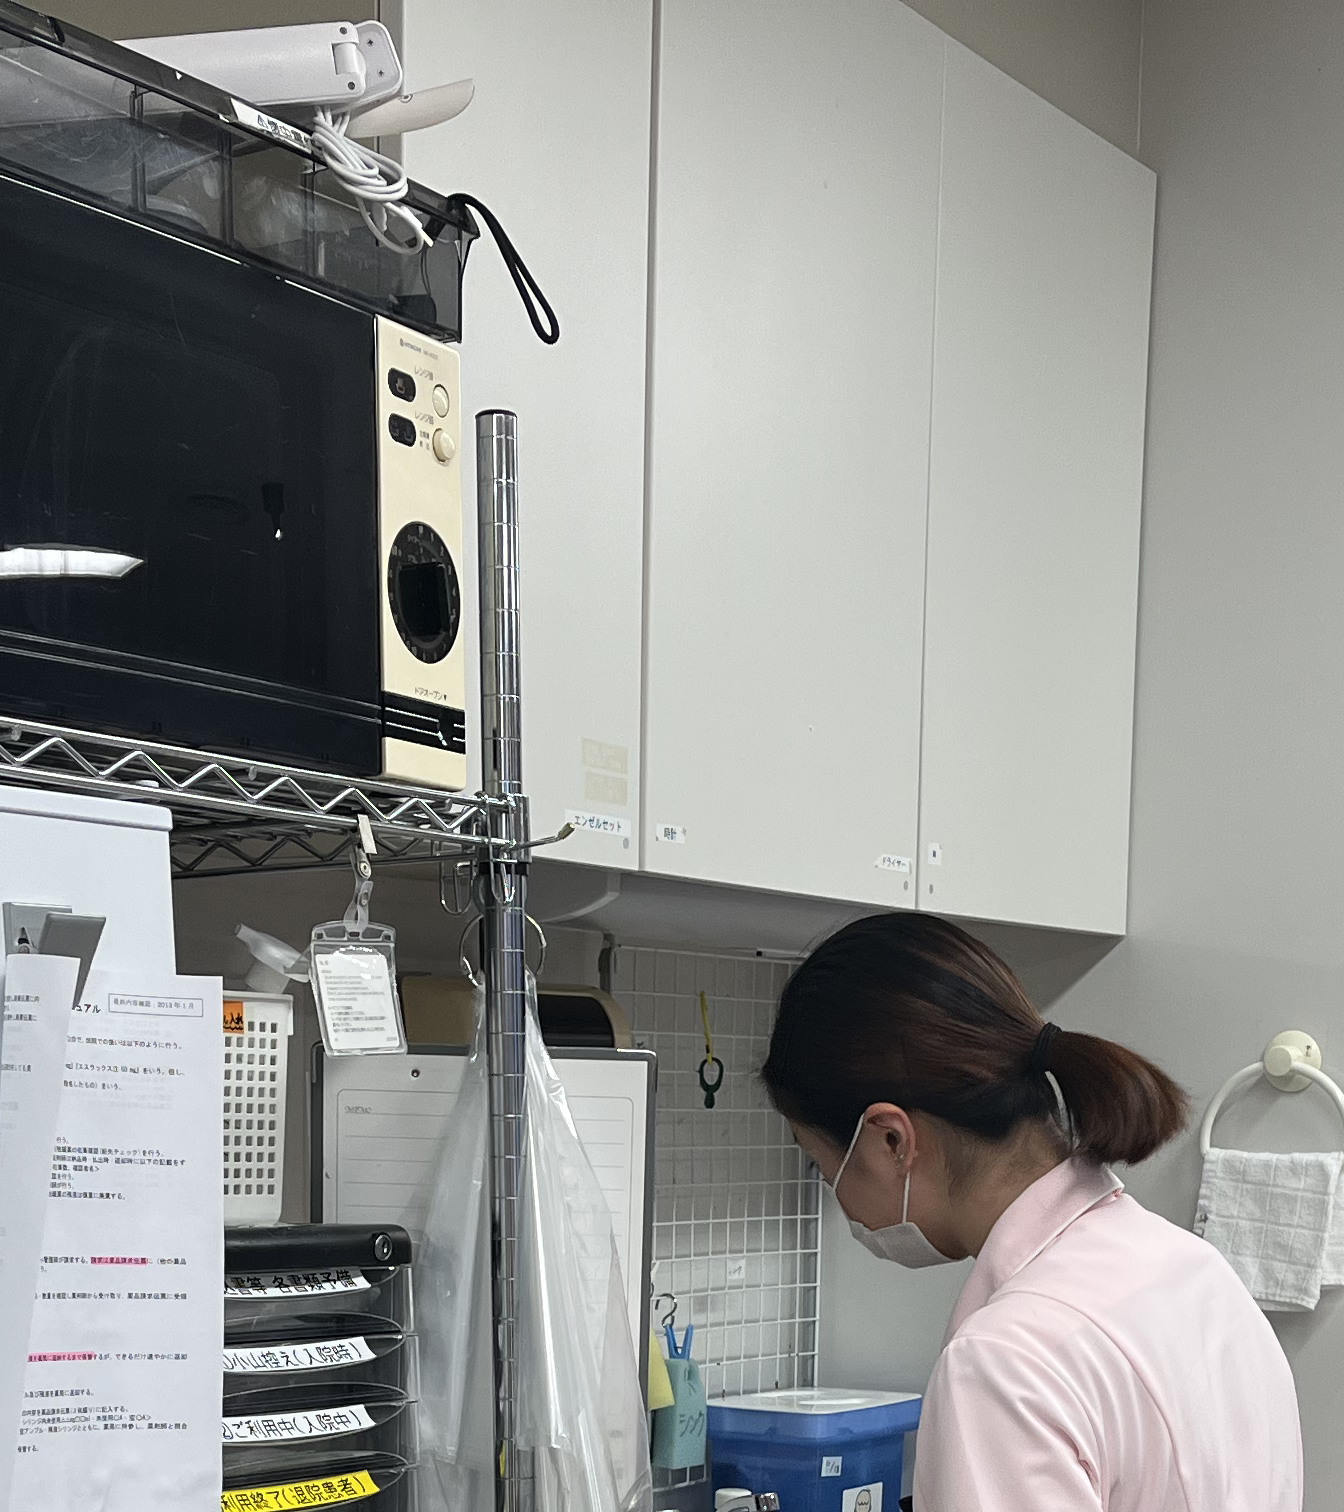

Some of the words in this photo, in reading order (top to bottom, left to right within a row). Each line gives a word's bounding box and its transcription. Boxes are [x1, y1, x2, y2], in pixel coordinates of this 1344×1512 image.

[574, 815, 622, 833] エンゼルセット
[272, 1269, 357, 1295] 各書類予備
[679, 1411, 706, 1438] シンク
